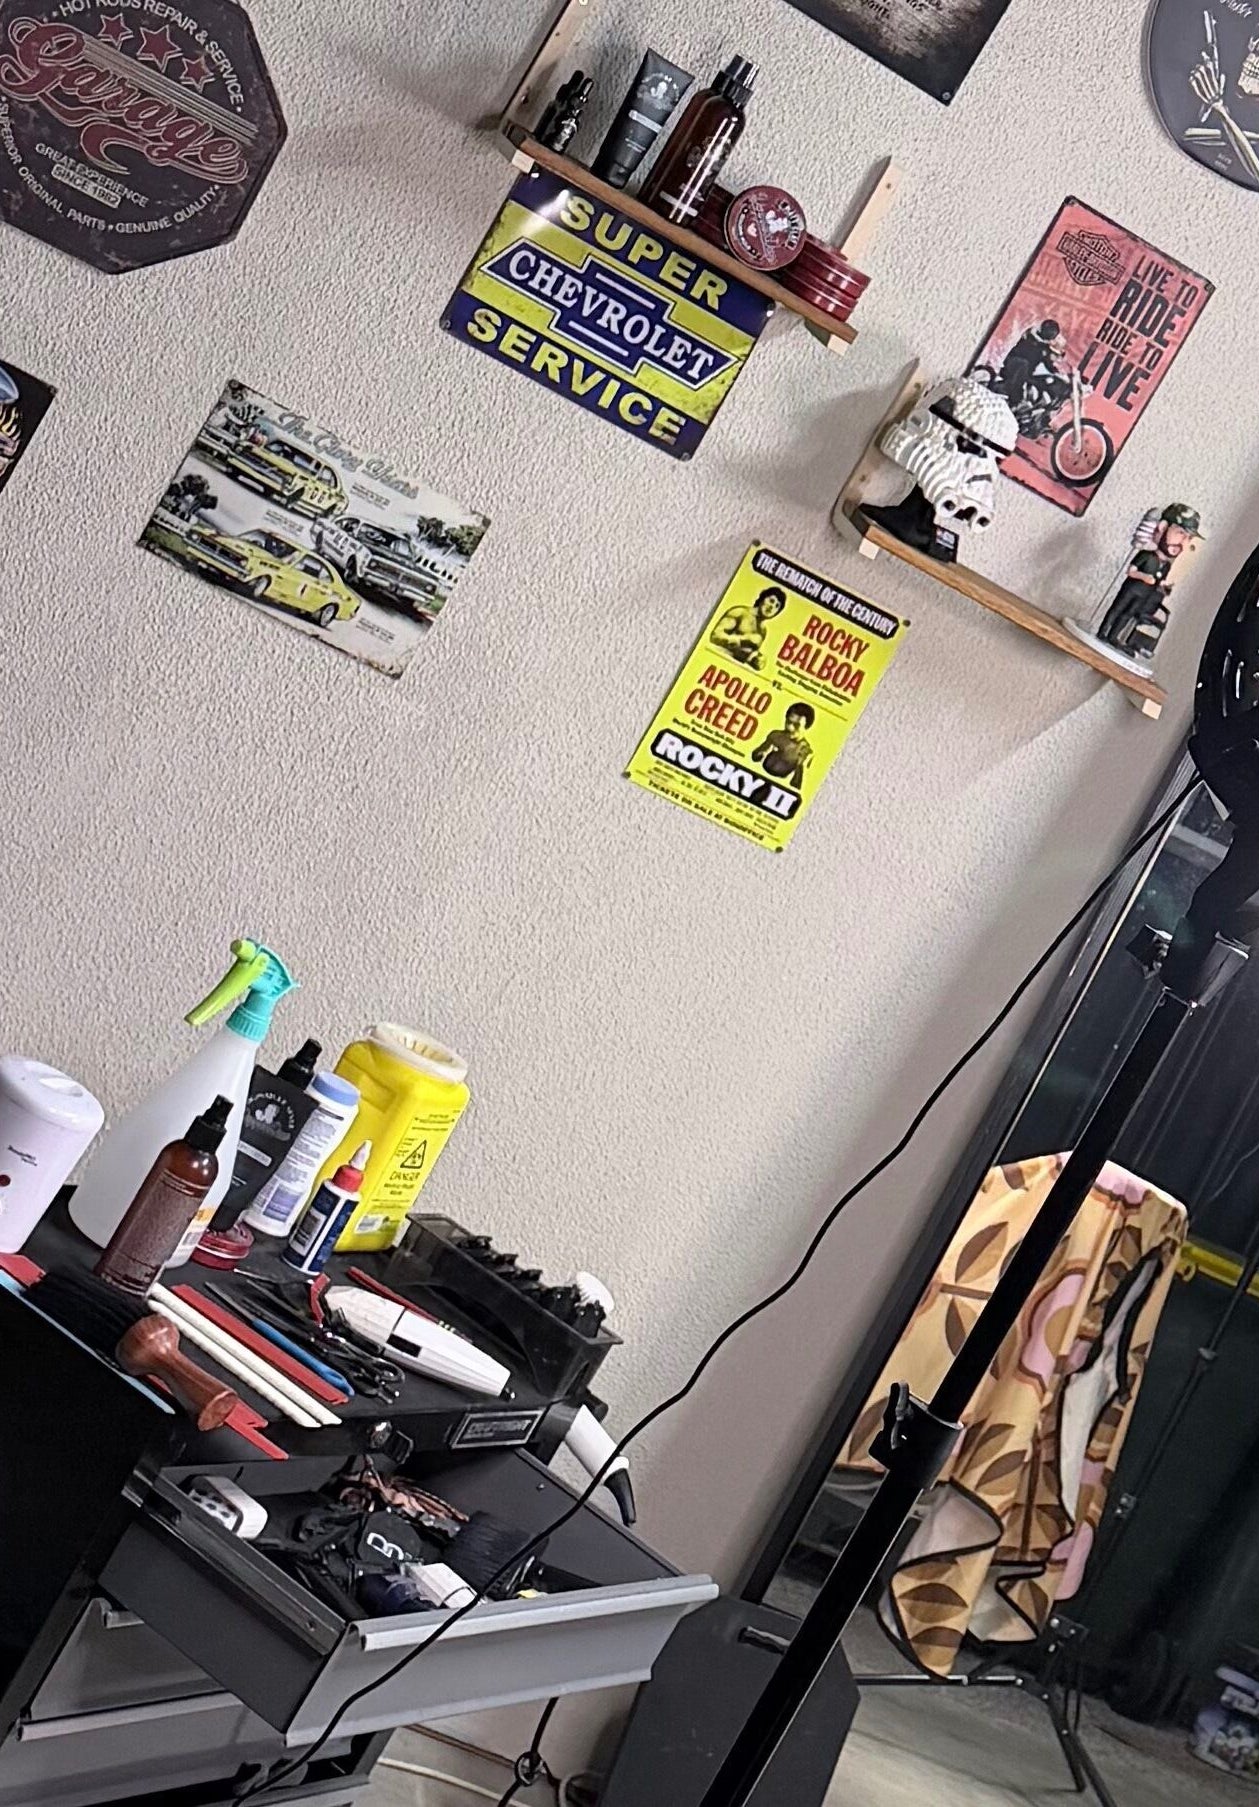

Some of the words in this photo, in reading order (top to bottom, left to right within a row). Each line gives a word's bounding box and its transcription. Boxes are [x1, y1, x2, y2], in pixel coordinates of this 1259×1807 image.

[143, 0, 198, 35] REPAIR
[203, 41, 244, 105] SERVICE
[0, 17, 249, 184] Garage
[18, 166, 63, 214] ORIGINAL
[67, 208, 105, 231] PARTS
[36, 143, 76, 168] GREAT
[76, 163, 149, 207] EXPERIENCE
[116, 216, 173, 234] GENUINE
[174, 186, 218, 223] QUALITY
[560, 195, 728, 310] SUPER
[1131, 254, 1174, 293] LIVE
[1175, 279, 1198, 308] TO
[508, 249, 714, 381] CHEVROLET
[1096, 318, 1137, 355] RIDE
[1138, 341, 1163, 373] TO
[1109, 278, 1187, 348] RIDE
[467, 308, 687, 445] SERVICE
[1077, 341, 1150, 412] LIVE
[756, 552, 778, 574] THE
[775, 562, 823, 597] REMATCH
[820, 586, 838, 604] OF
[832, 593, 855, 615] THE
[851, 603, 896, 636] CENTURY
[777, 633, 865, 698] BALBOA
[802, 614, 870, 662] ROCKY
[684, 688, 758, 741] CREED
[697, 664, 772, 715] APOLLO
[656, 732, 765, 798] ROCKY
[762, 784, 798, 817] II
